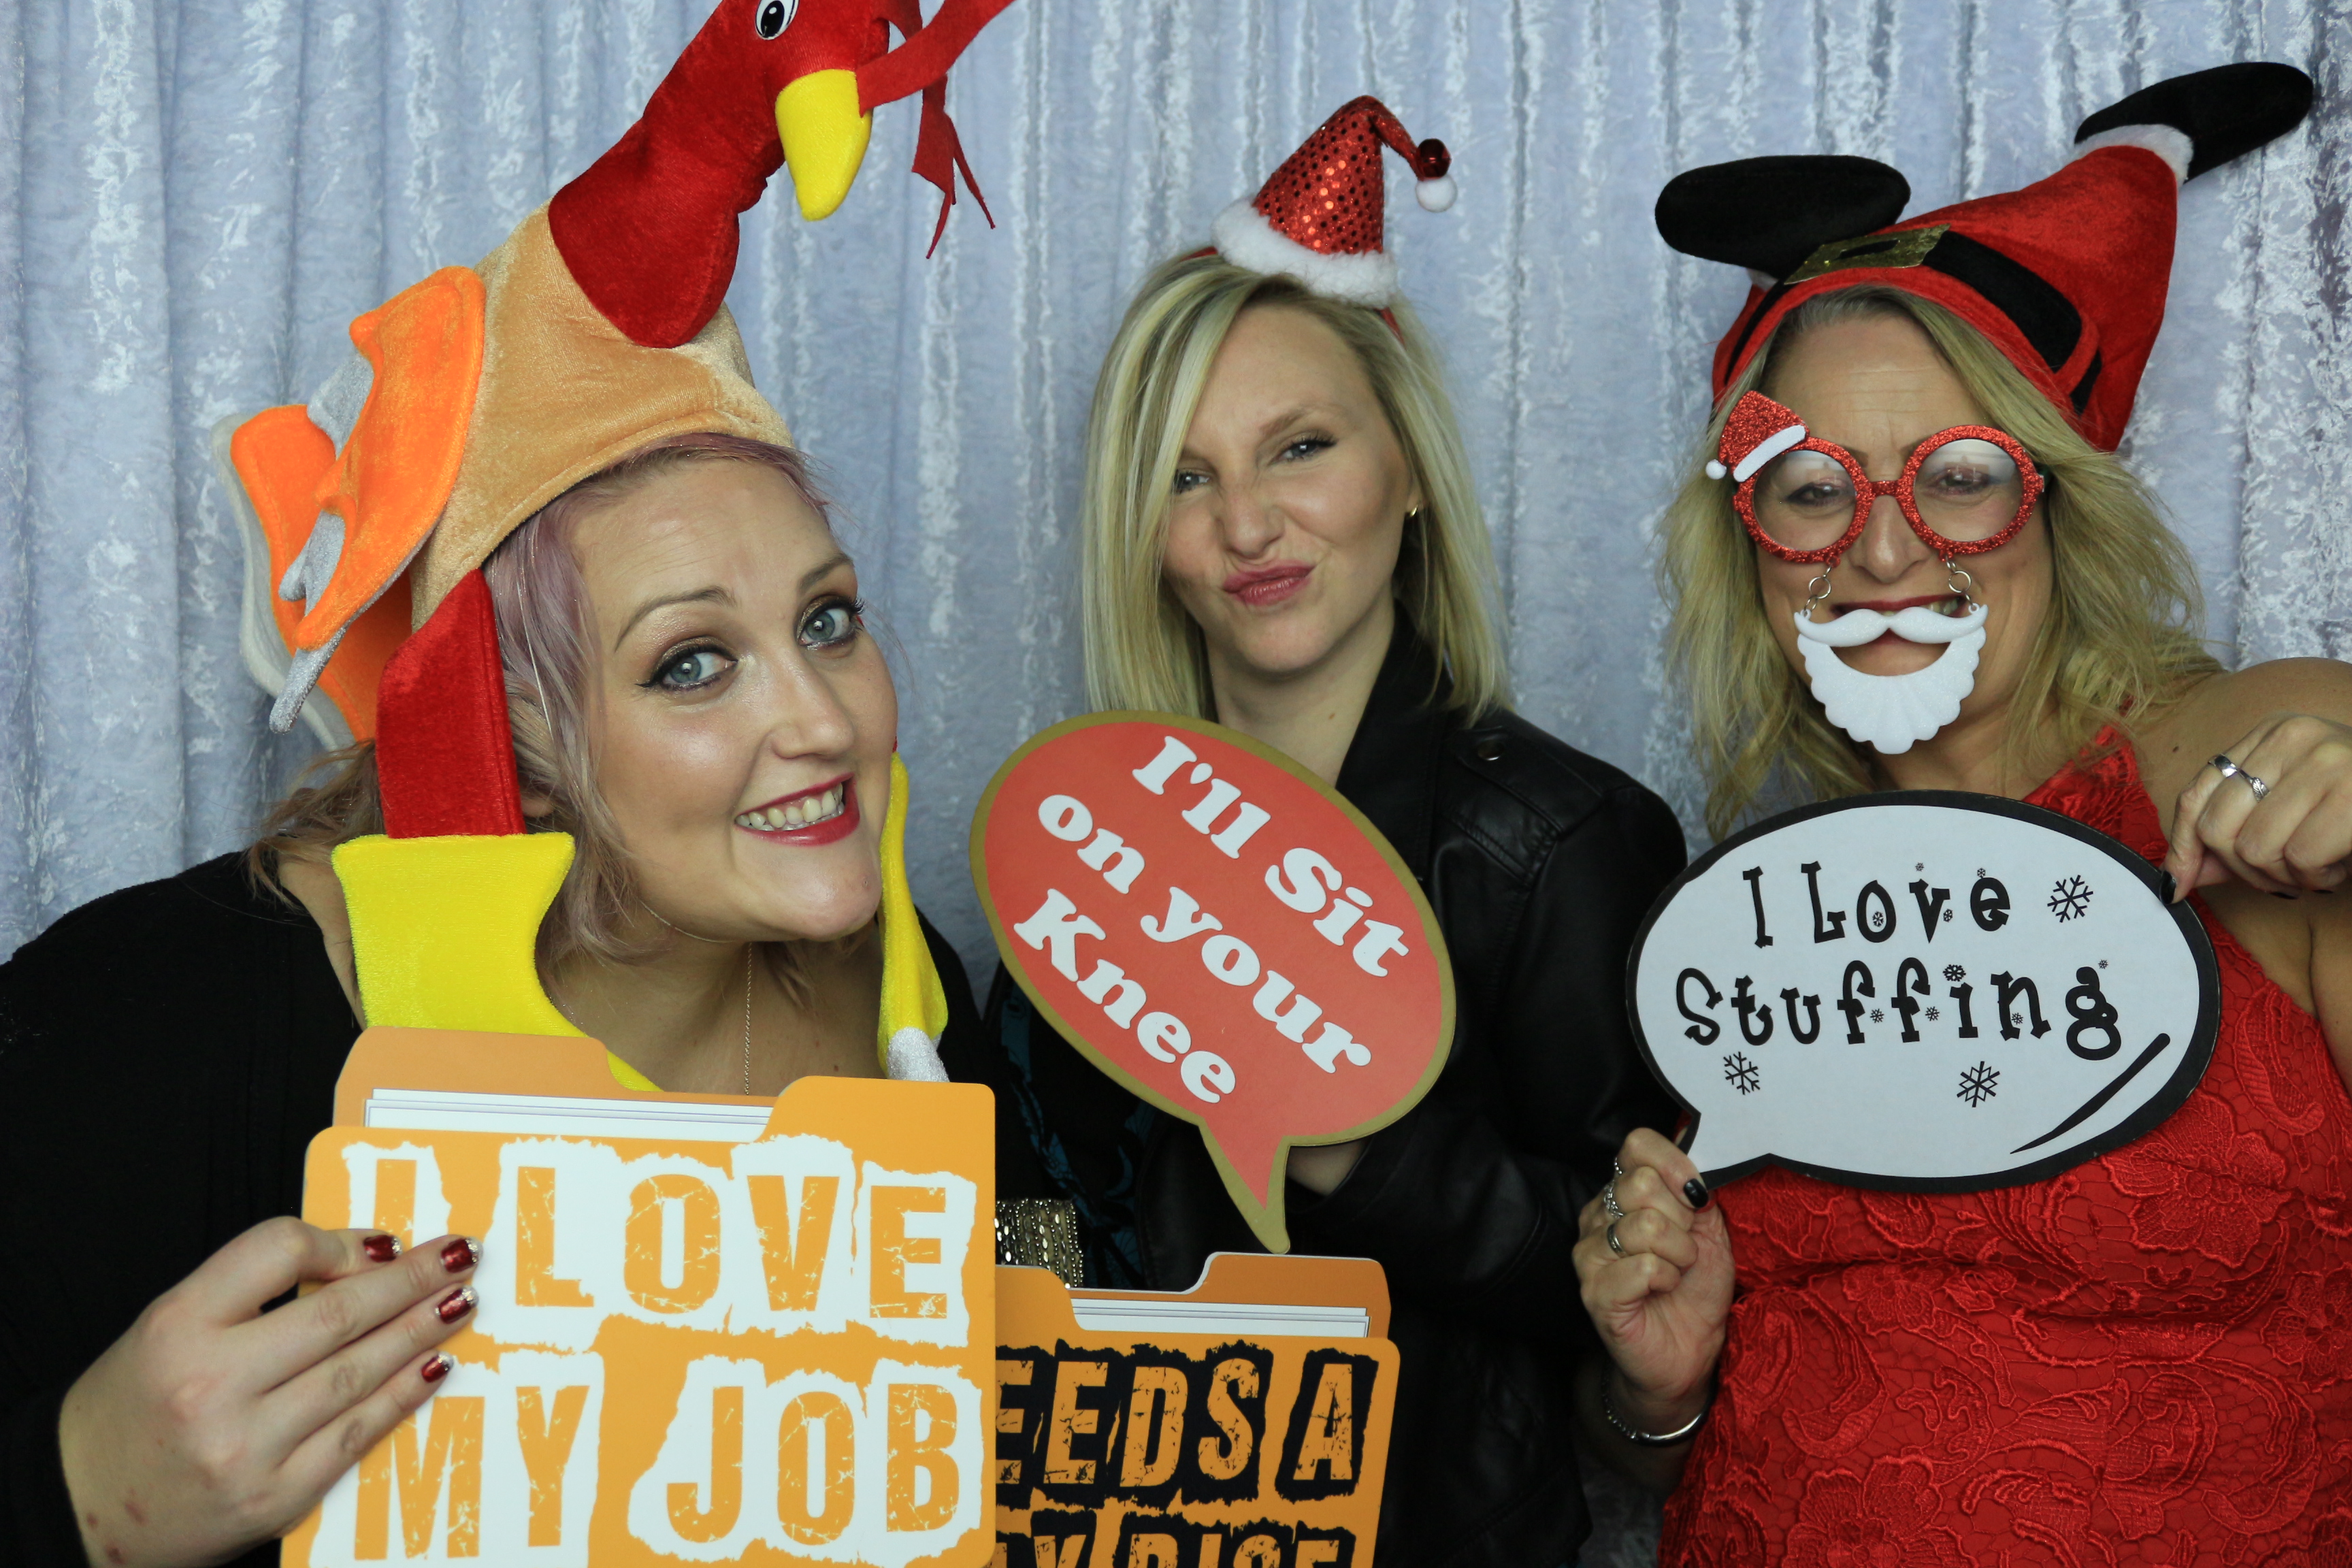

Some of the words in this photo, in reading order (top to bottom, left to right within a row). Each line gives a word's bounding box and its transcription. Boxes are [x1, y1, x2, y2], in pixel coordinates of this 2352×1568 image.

[1038, 794, 1146, 894] on
[1140, 886, 1371, 1074] your
[1132, 736, 1271, 859] I'll
[1264, 847, 1409, 977] Sit
[1742, 866, 1774, 949] I
[1800, 860, 2011, 944] Love
[1013, 888, 1237, 1103] Knee
[1676, 957, 2123, 1061] Stuffing
[515, 1166, 947, 1319] LOVE
[354, 1384, 589, 1561] MY
[666, 1383, 960, 1546] JOB
[996, 1358, 1260, 1487] EEDS
[1293, 1363, 1352, 1480] A
